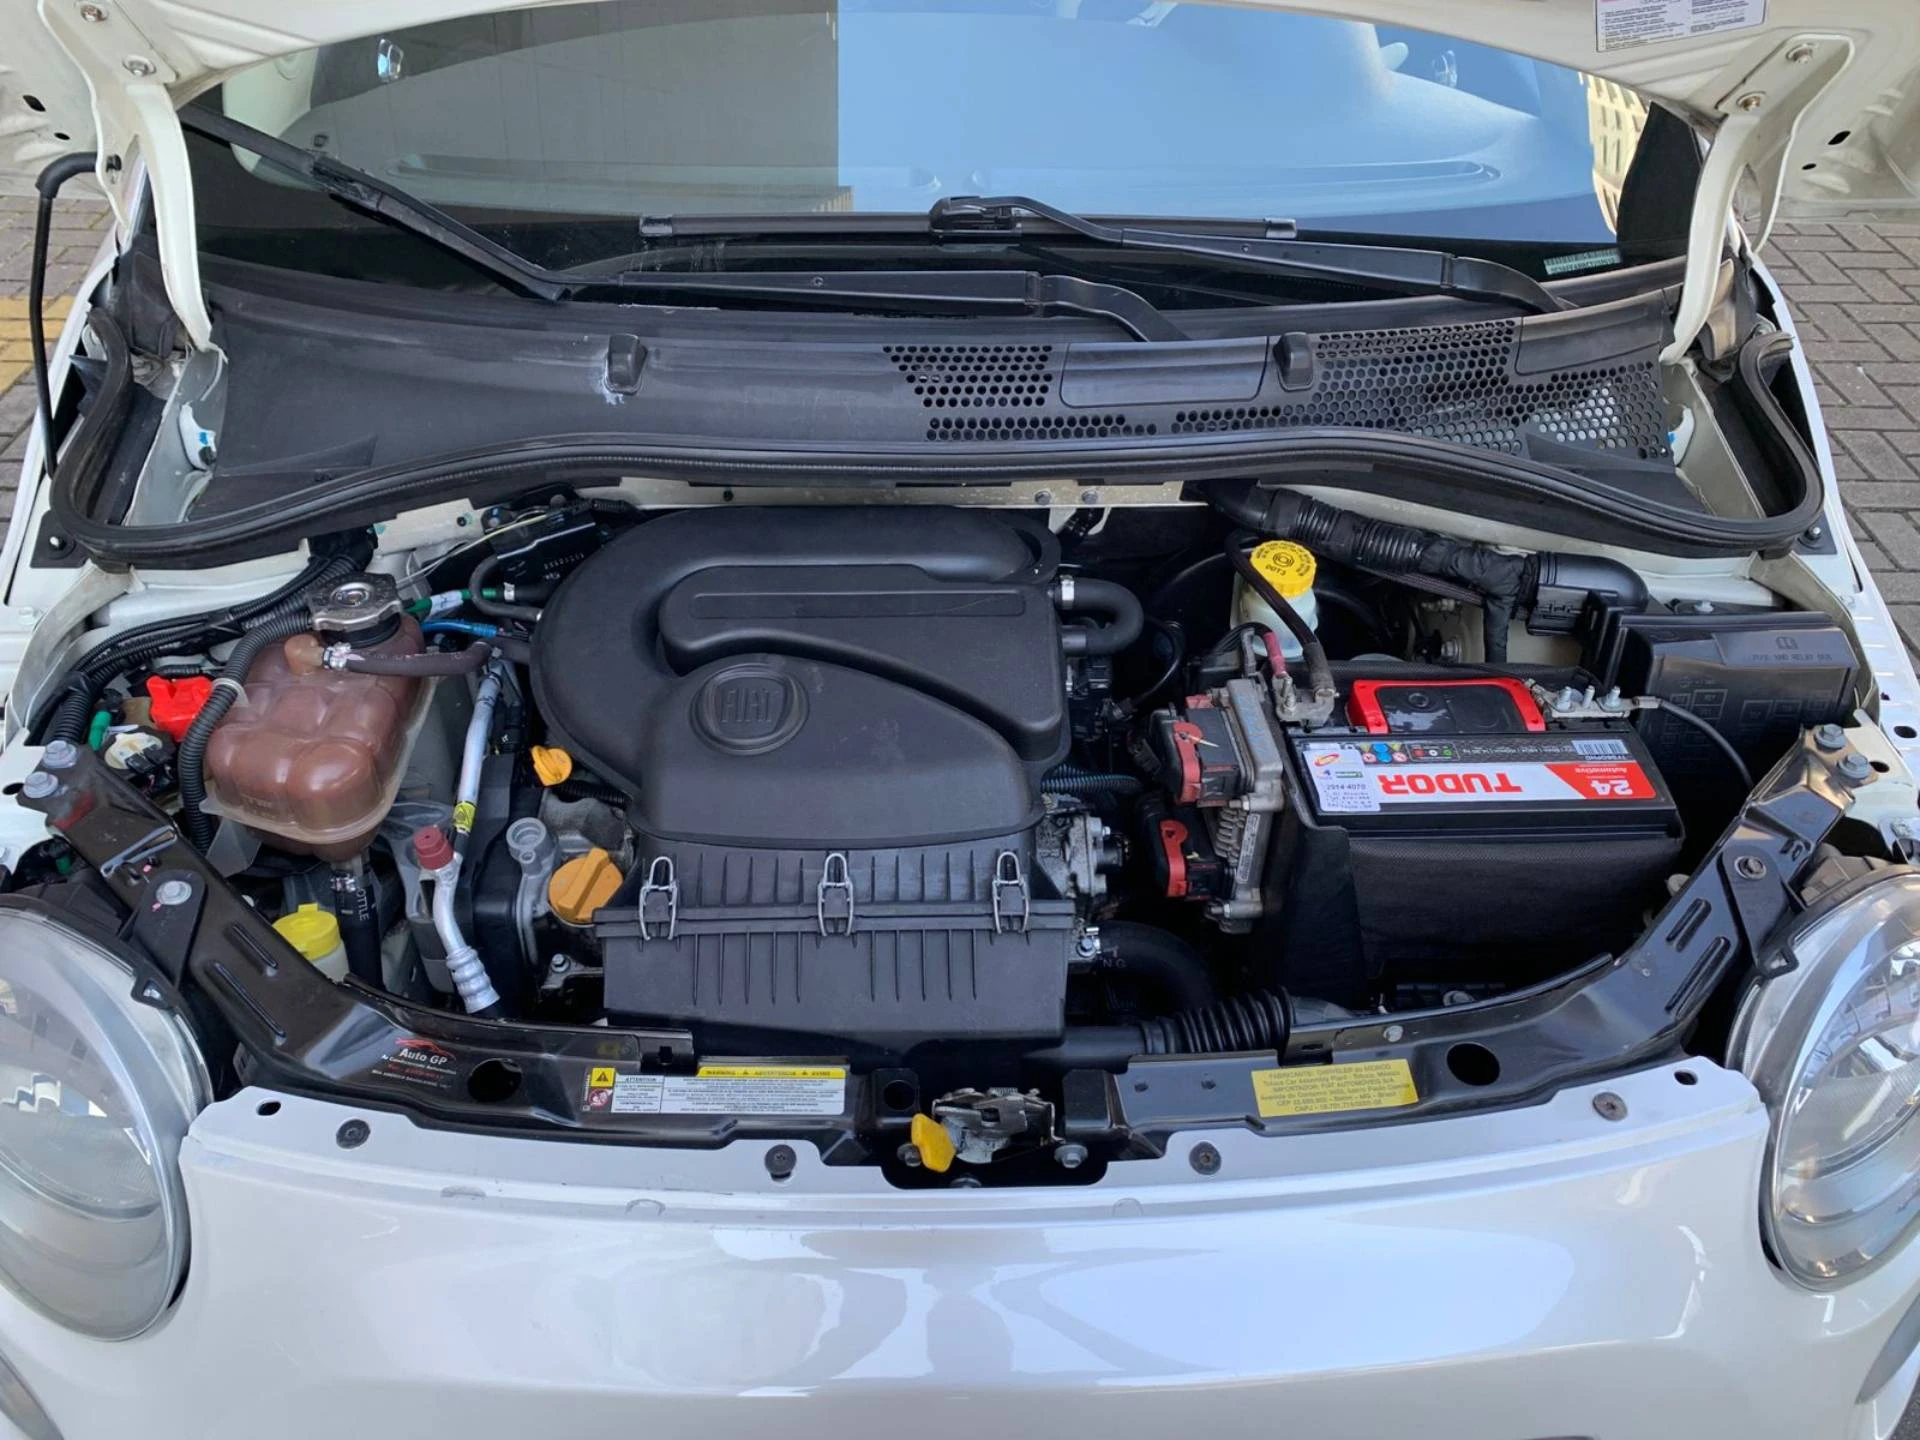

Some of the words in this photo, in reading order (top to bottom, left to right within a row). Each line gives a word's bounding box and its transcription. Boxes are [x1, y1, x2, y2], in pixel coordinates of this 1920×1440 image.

[720, 687, 780, 723] FIAT
[1377, 773, 1523, 795] TUDOR
[1591, 779, 1633, 796] 24
[399, 1048, 427, 1062] Auto
[429, 1055, 448, 1065] GP
